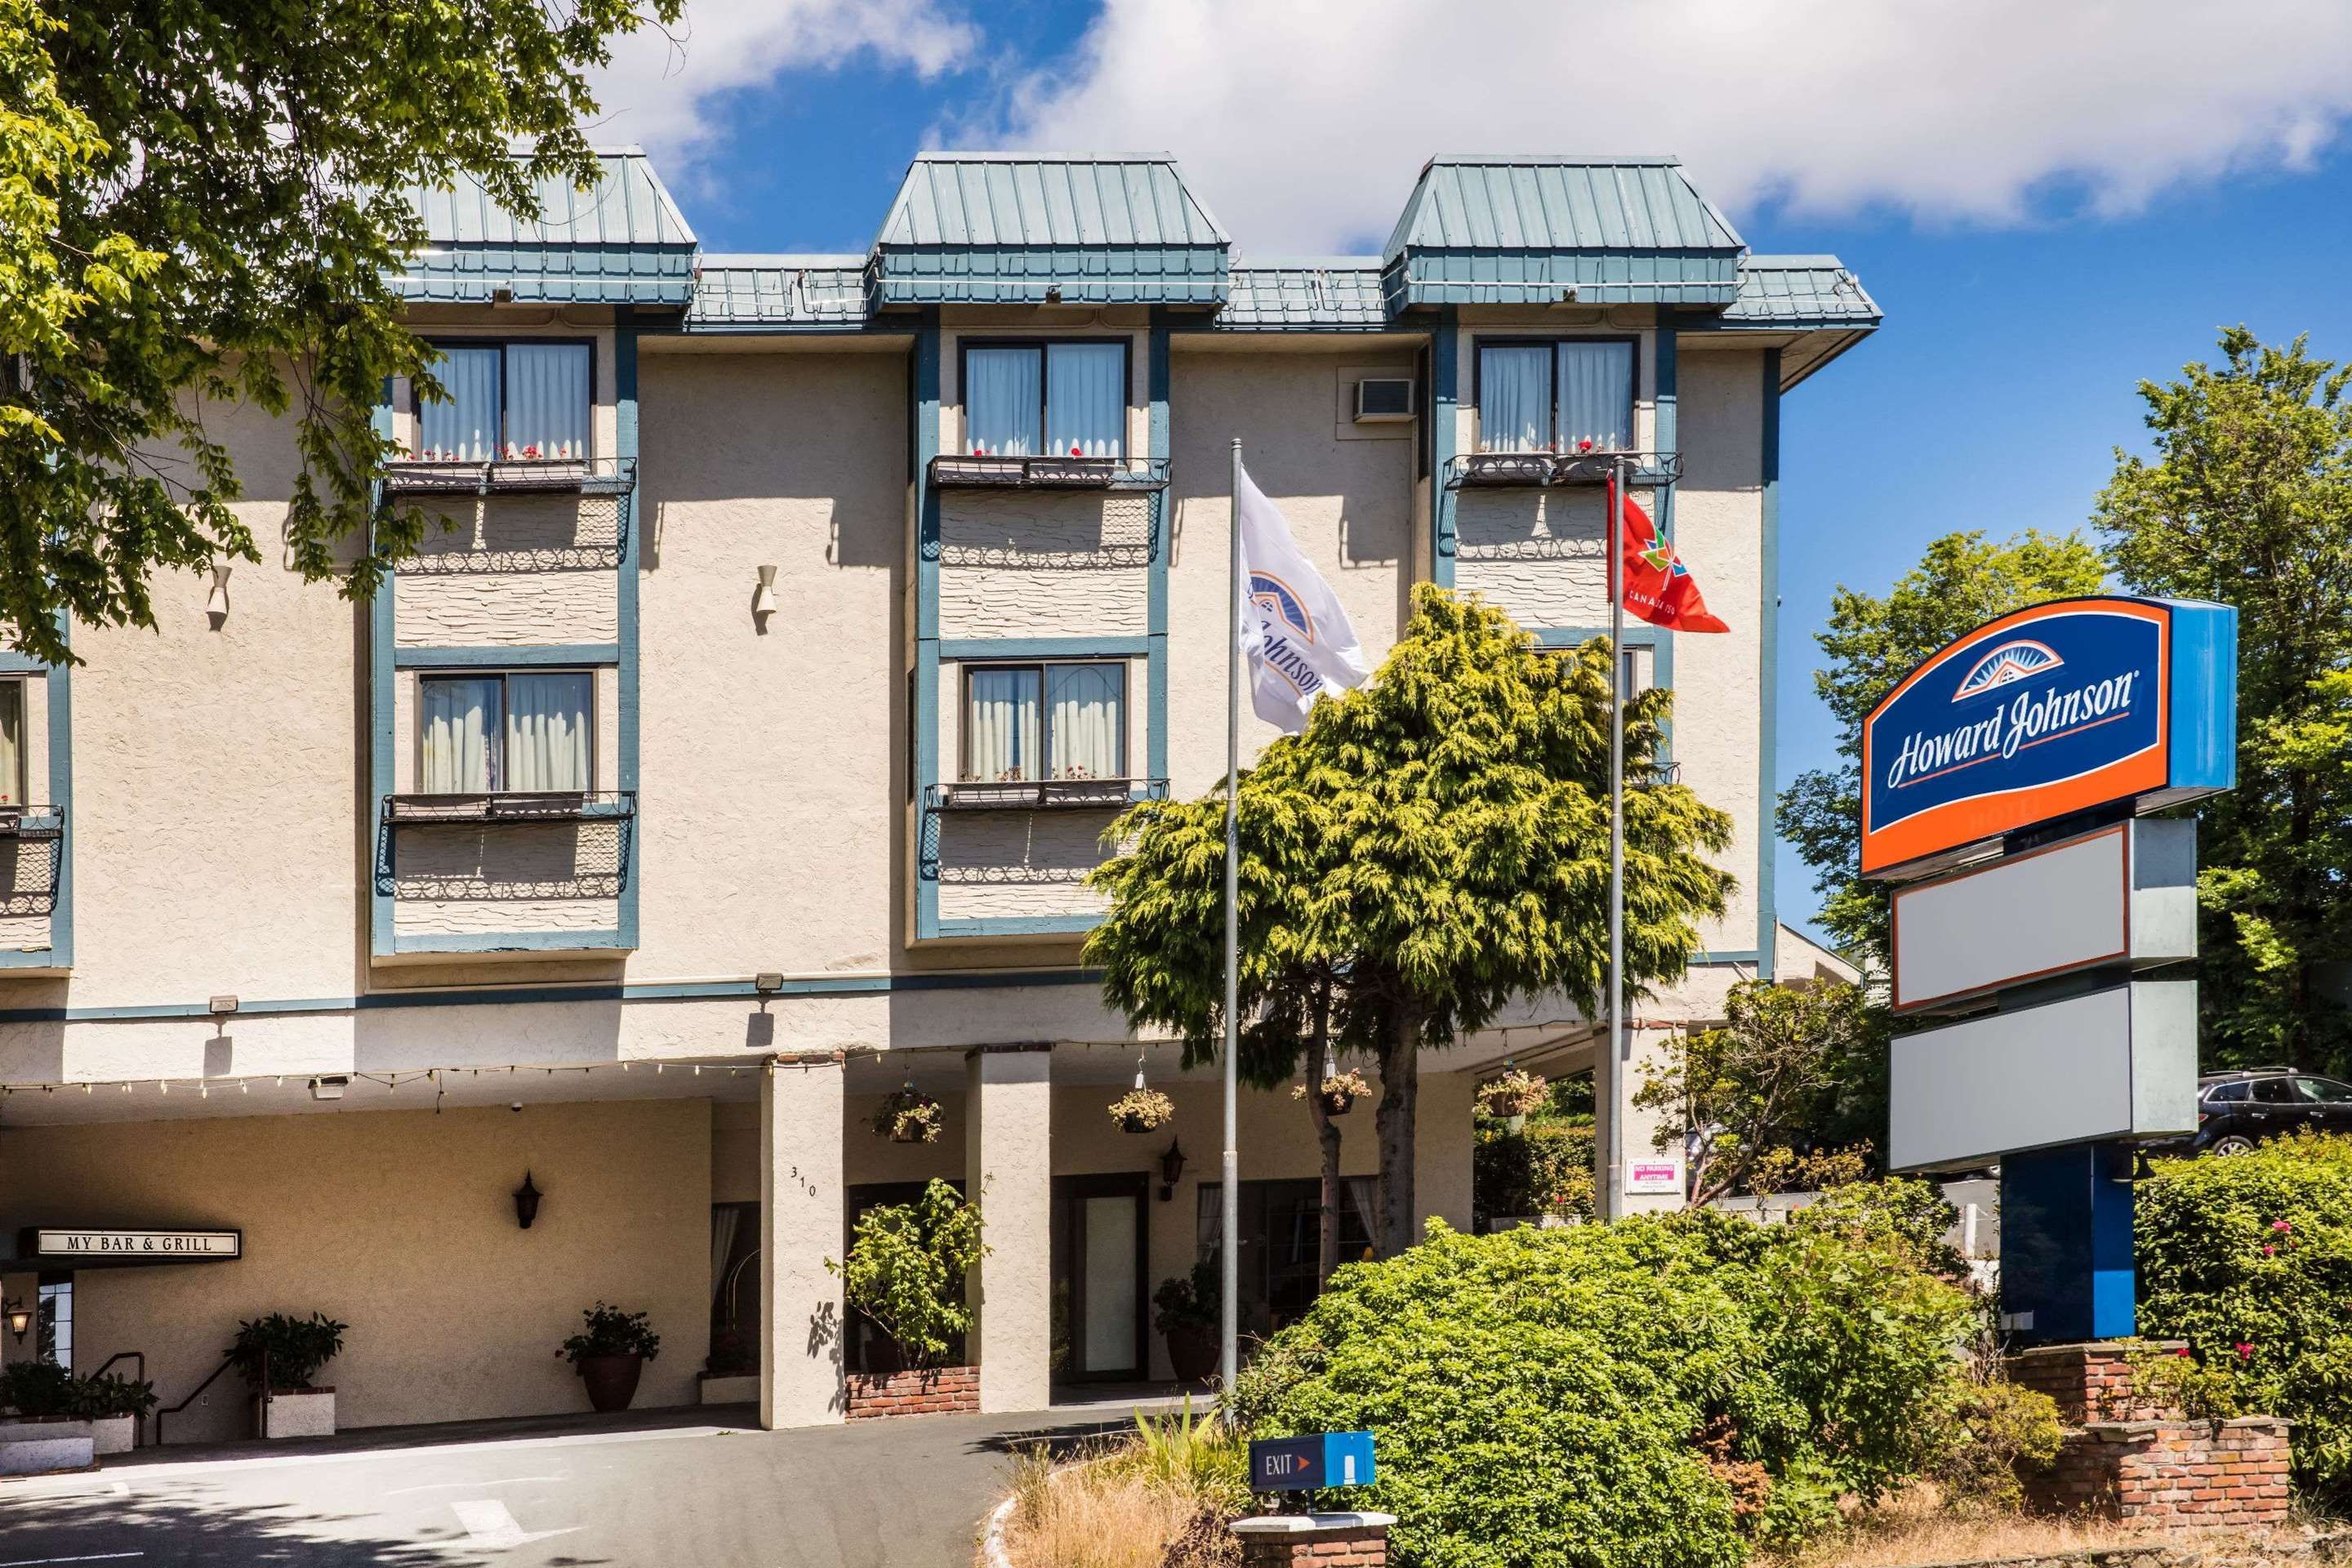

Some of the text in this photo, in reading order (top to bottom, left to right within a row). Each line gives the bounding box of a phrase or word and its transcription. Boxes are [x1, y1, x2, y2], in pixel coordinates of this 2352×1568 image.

[1261, 620, 1323, 695] ohnson
[1888, 671, 2133, 789] Howard Johnson
[791, 1166, 816, 1197] 310
[67, 1236, 212, 1251] MY BAR & GRILL
[1266, 1454, 1292, 1475] EXIT
